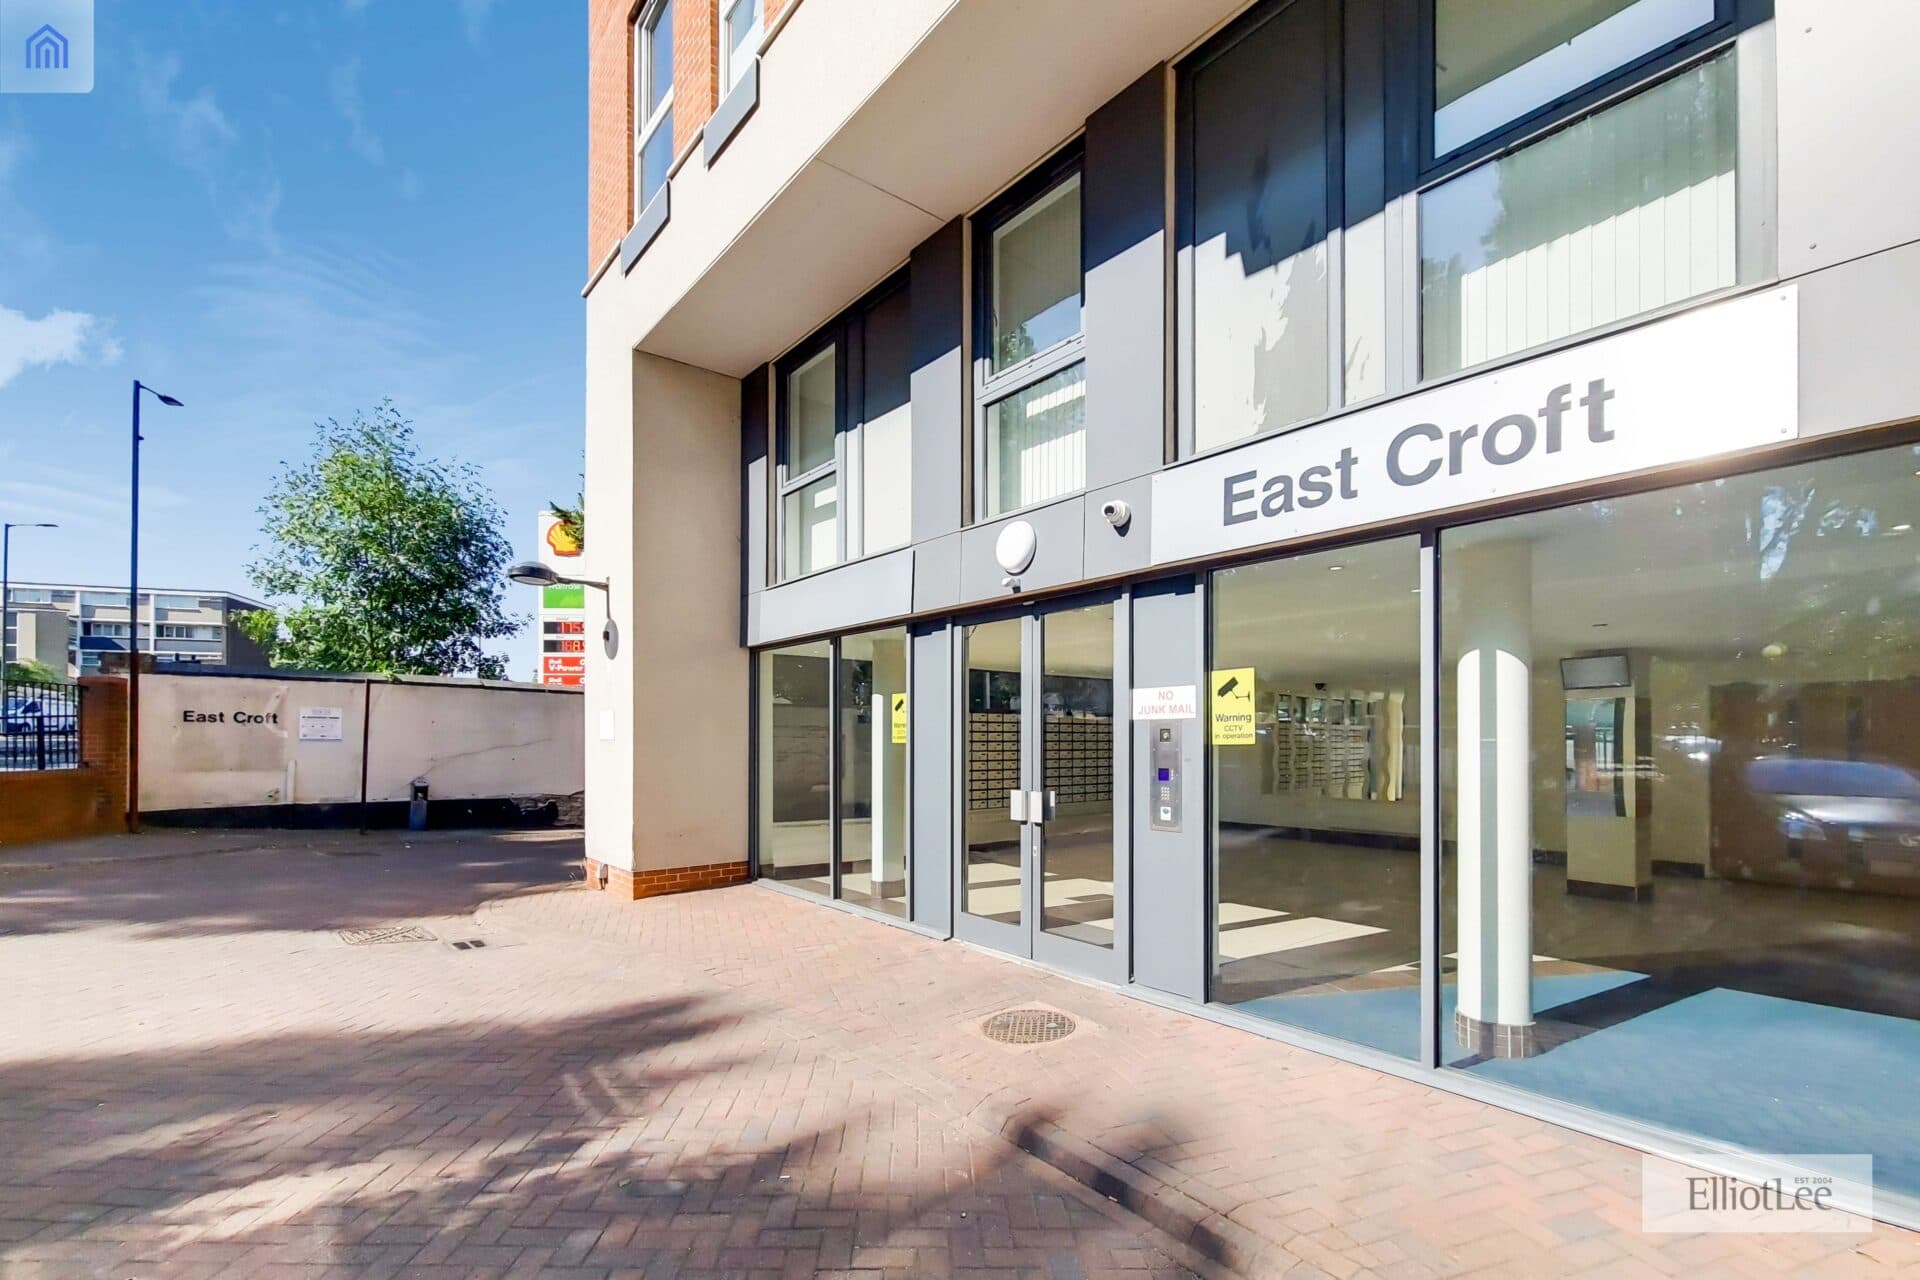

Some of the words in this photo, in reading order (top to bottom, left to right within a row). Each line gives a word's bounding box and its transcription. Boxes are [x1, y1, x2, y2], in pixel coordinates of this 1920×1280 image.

[1223, 447, 1358, 526] East
[1386, 378, 1616, 487] Croft
[1158, 690, 1174, 701] NO
[1138, 704, 1167, 715] JUNK
[1169, 703, 1195, 714] MAIL
[183, 710, 225, 723] East
[233, 711, 279, 724] Croft
[1215, 713, 1252, 723] Warning
